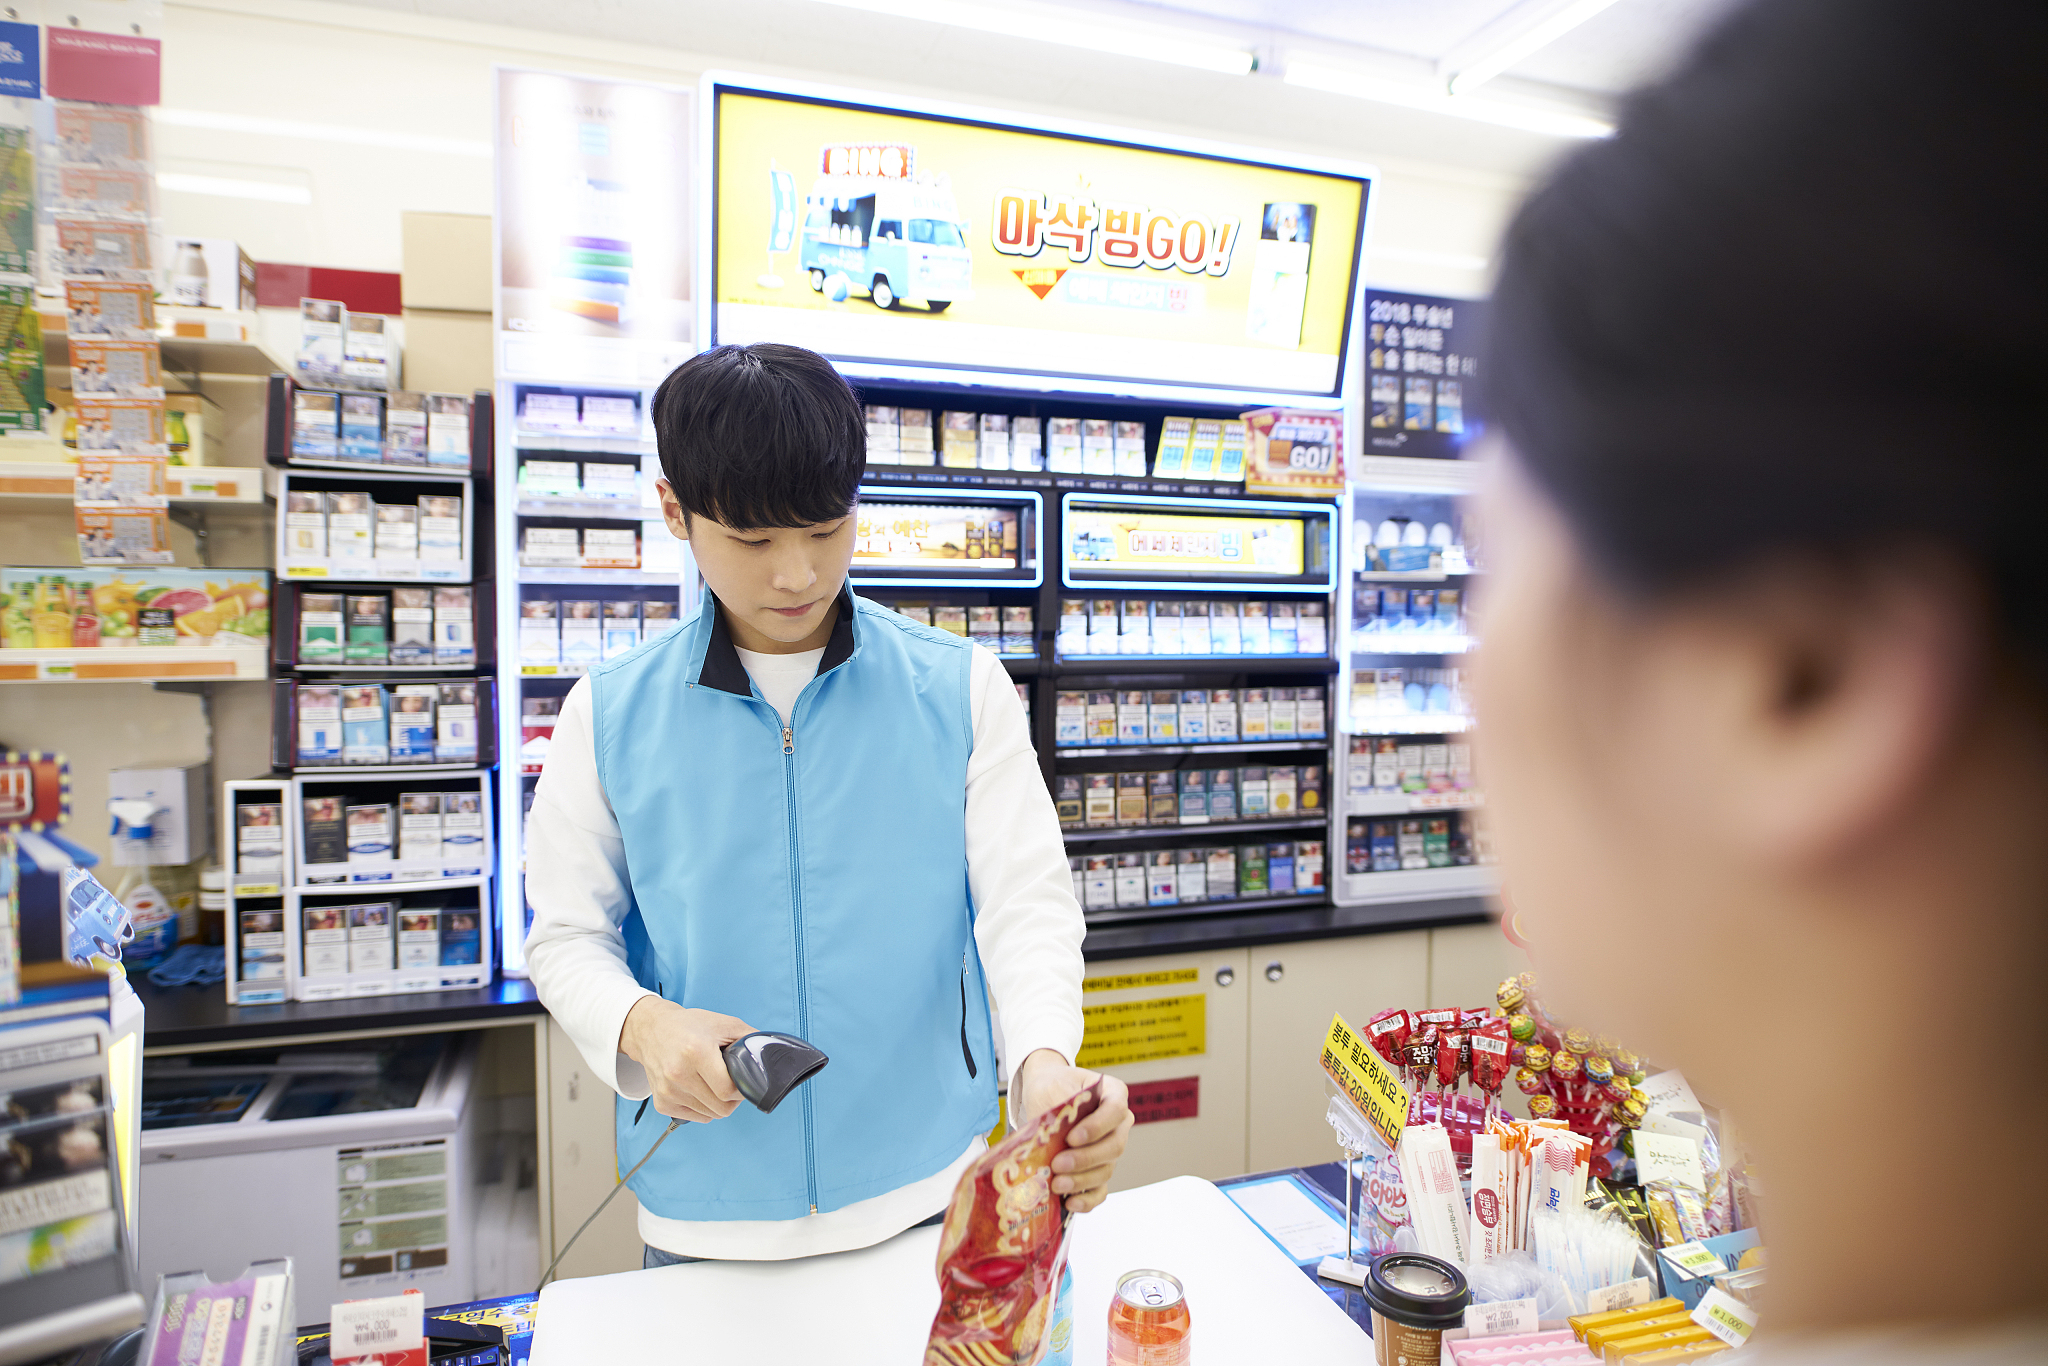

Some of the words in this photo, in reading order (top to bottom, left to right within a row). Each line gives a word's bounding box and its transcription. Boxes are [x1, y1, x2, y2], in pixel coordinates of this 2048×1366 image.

[999, 195, 1092, 253] 아삭
[1104, 208, 1231, 267] 빙GO!
[1290, 445, 1330, 470] GO!
[1323, 1047, 1350, 1089] 봉투값
[1349, 1079, 1401, 1149] 20원입니다
[1332, 1022, 1351, 1050] 봉투
[1350, 1041, 1397, 1105] 필요하세요
[1400, 1095, 1407, 1113] ?
[1478, 1192, 1494, 1224] 정면승부
